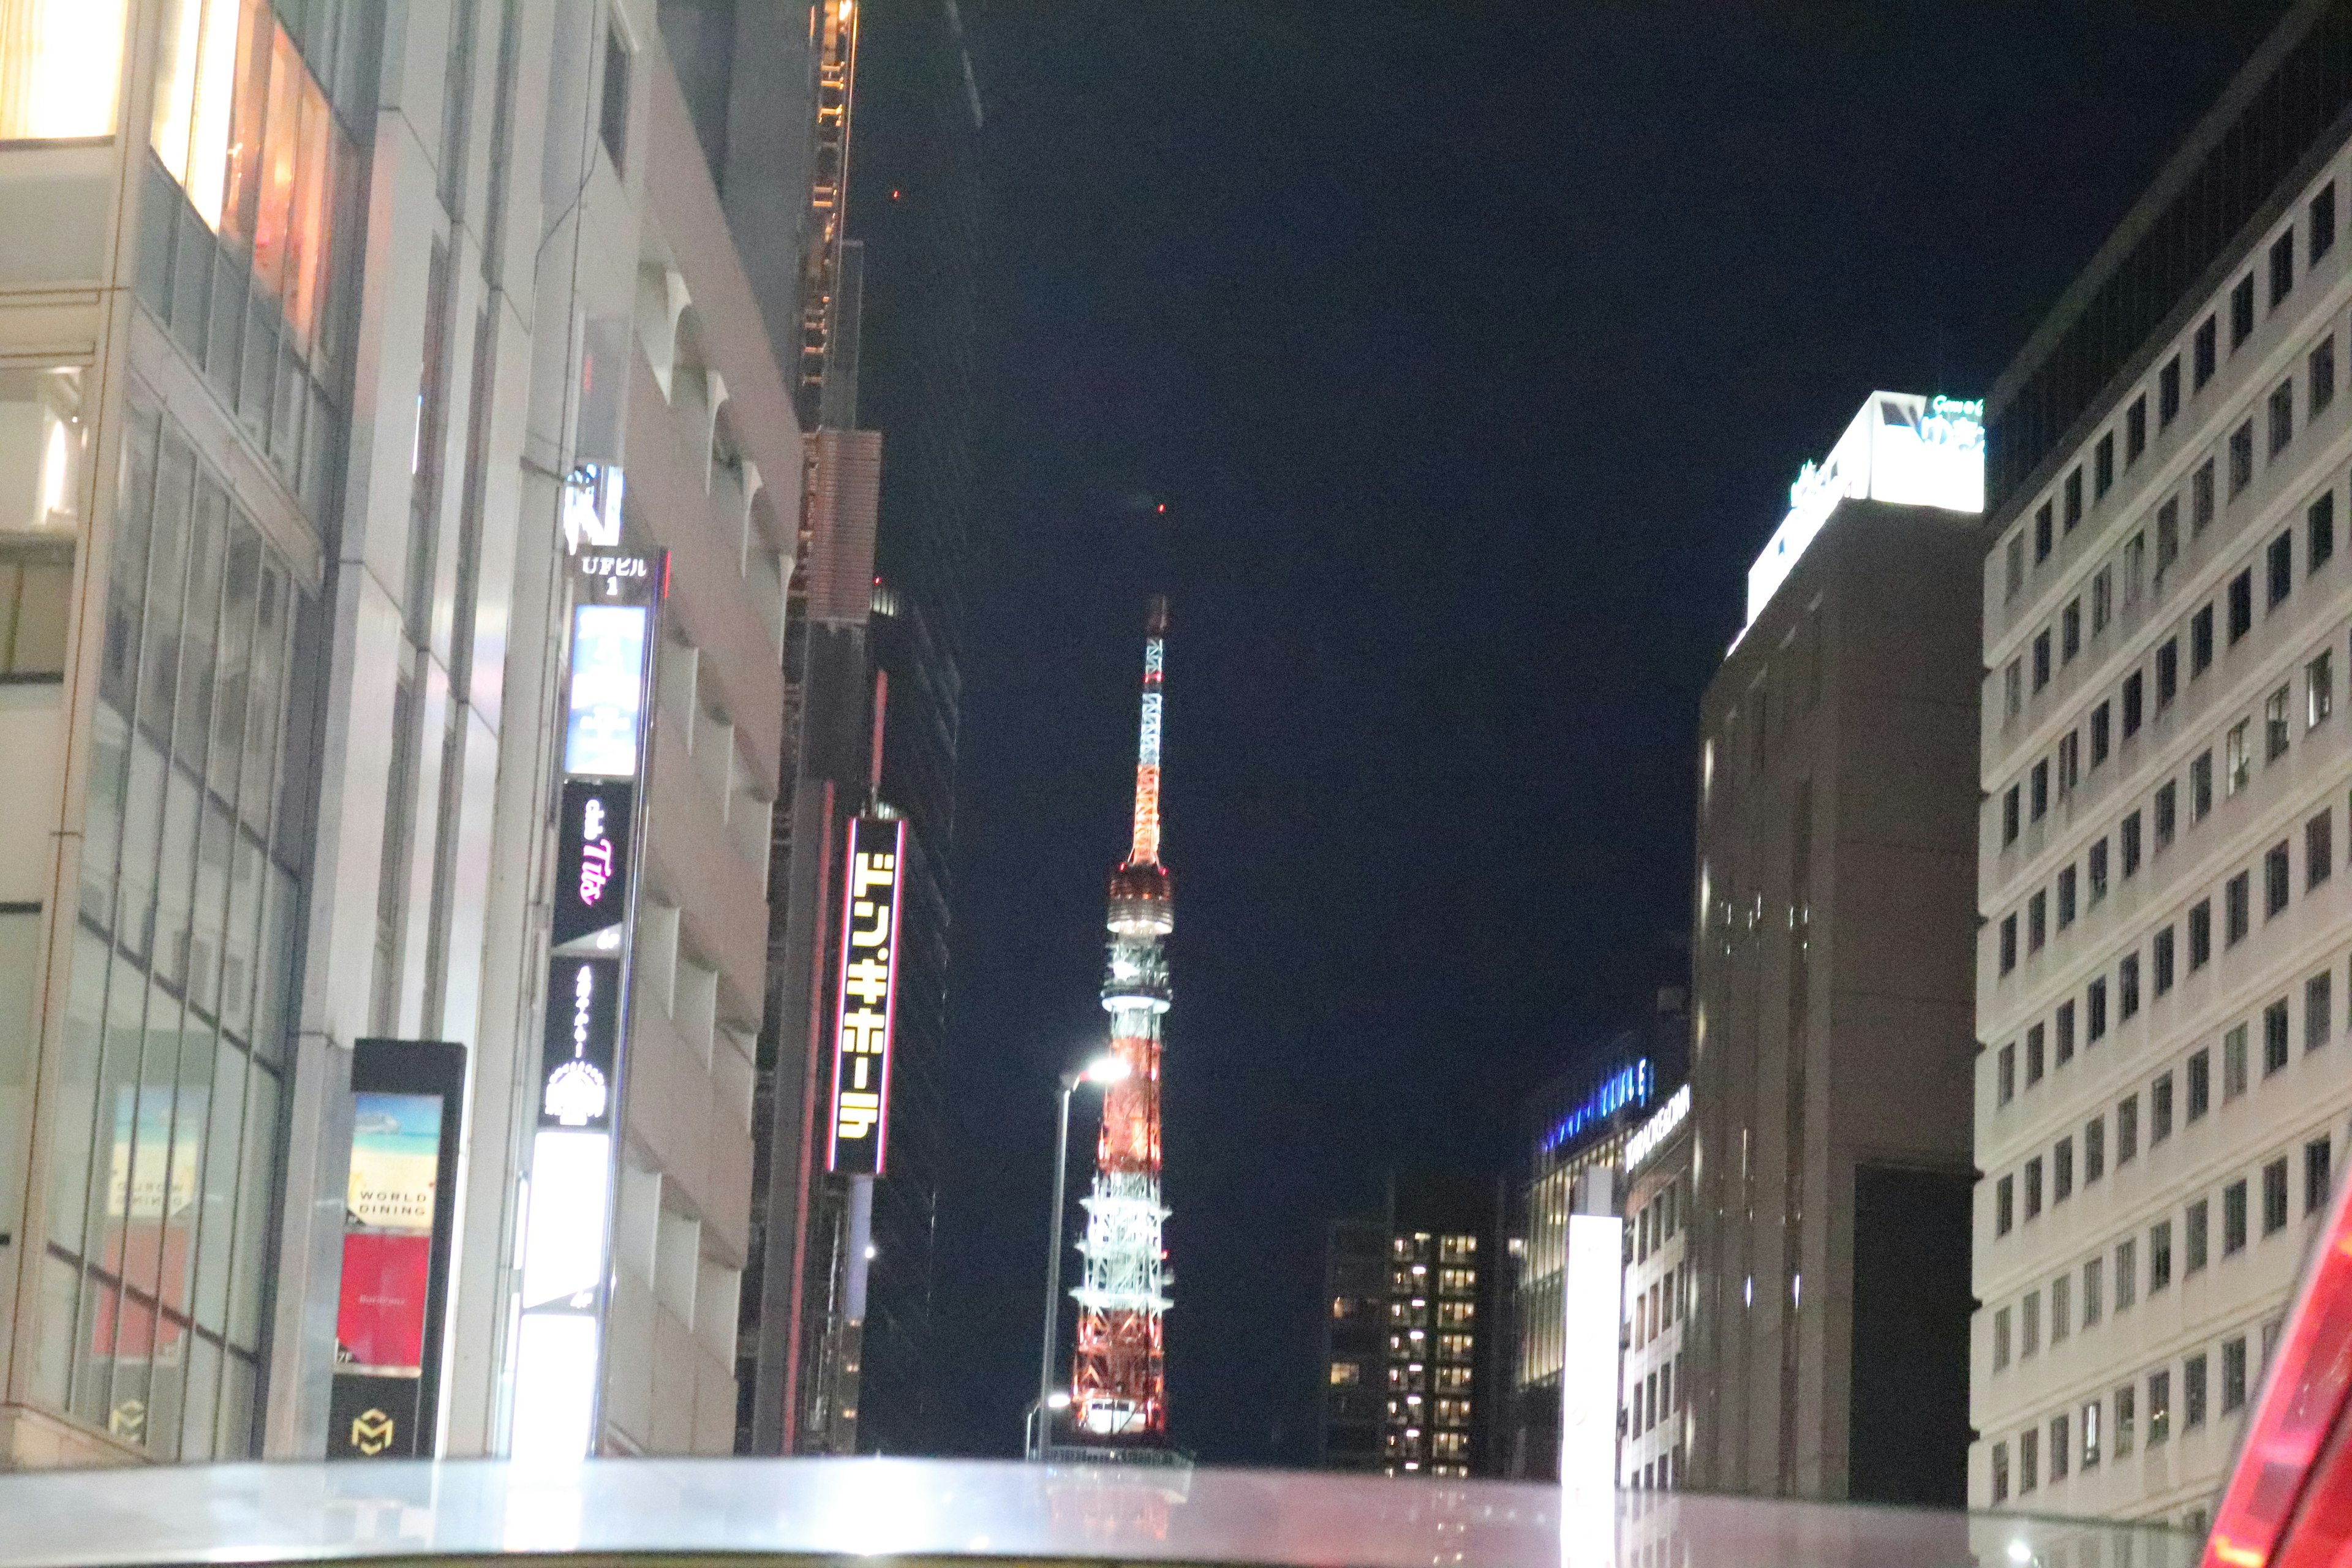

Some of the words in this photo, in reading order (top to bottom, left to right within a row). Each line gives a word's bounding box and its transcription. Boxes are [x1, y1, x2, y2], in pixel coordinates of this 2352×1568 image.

[606, 576, 618, 595] 1
[360, 1191, 426, 1202] WORLD
[359, 1204, 426, 1216] DINING
